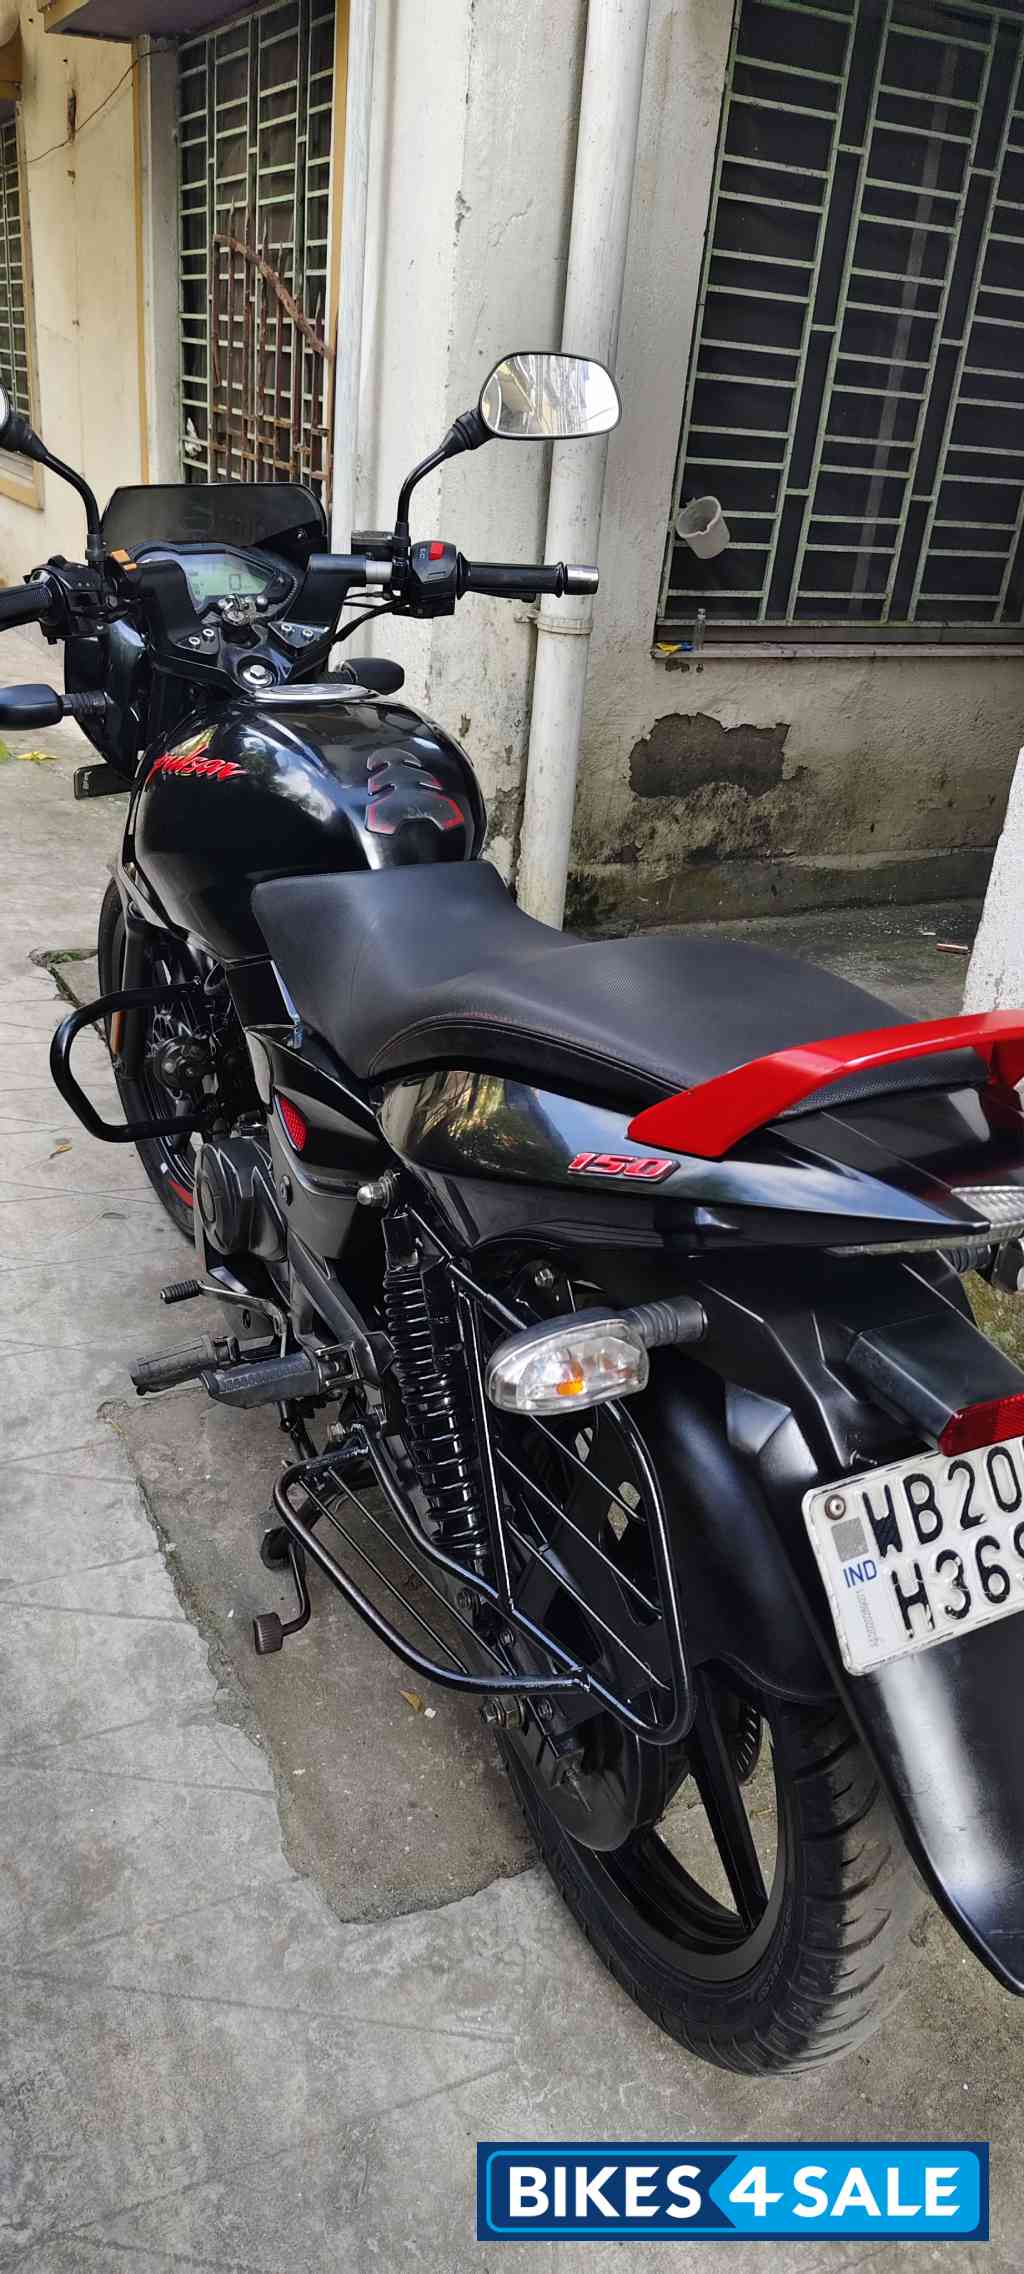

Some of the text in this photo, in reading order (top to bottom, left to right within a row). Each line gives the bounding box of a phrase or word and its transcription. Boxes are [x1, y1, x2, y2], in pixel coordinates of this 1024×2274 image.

[567, 1152, 674, 1178] 150
[862, 1438, 1024, 1559] WB20
[843, 1559, 877, 1588] IND
